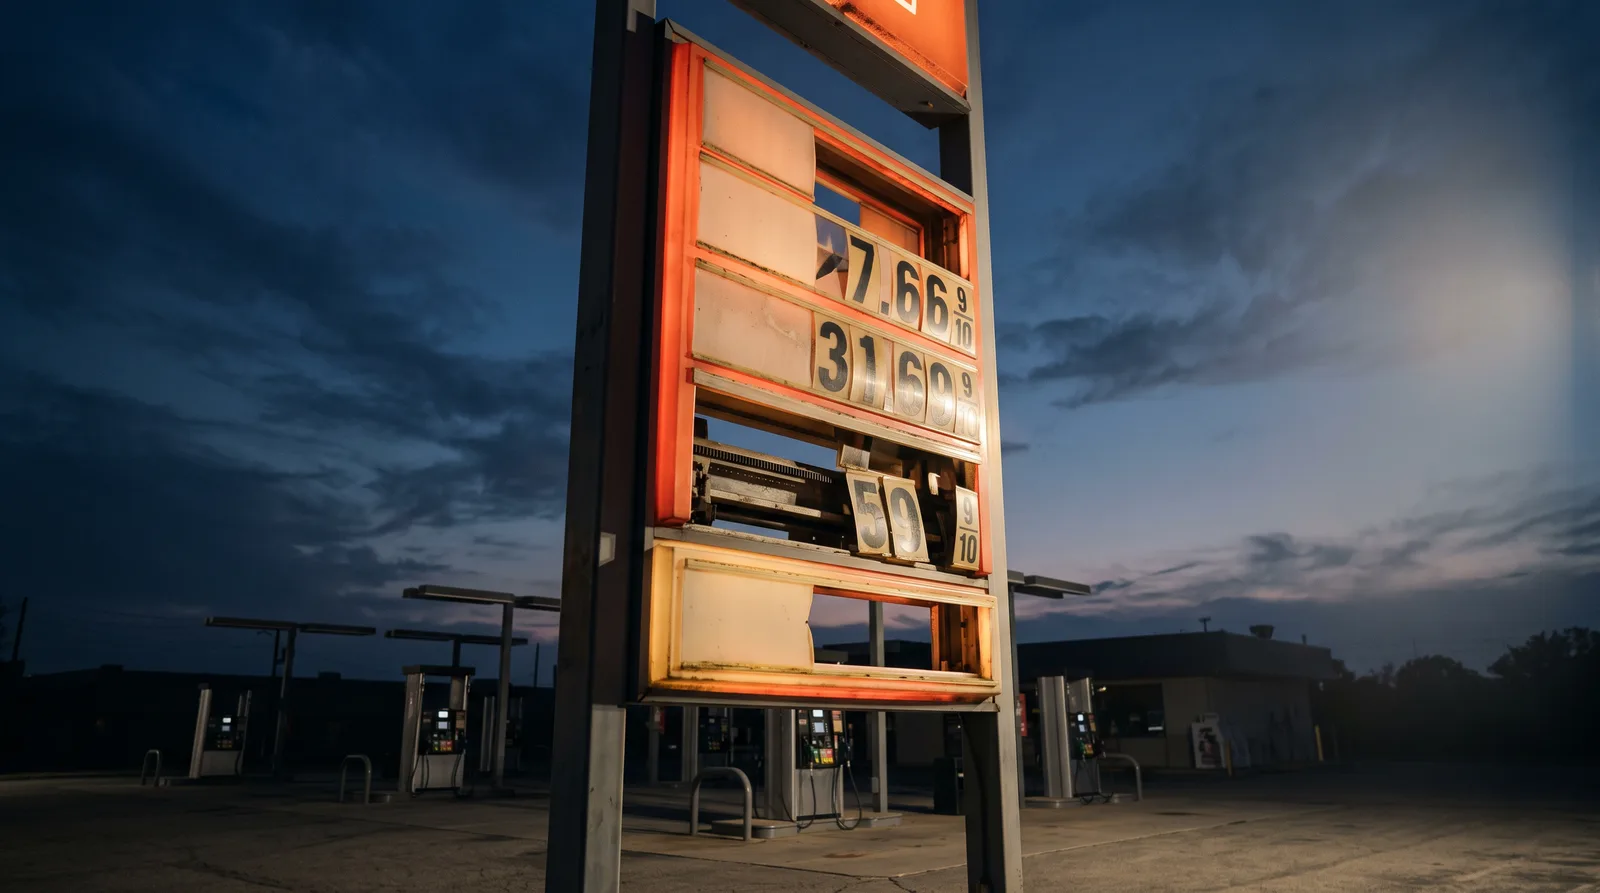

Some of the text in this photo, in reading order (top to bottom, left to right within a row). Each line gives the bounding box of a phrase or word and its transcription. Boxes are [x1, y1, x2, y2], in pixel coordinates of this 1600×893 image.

[850, 234, 948, 334] 7.66
[853, 480, 920, 553] 59
[960, 533, 978, 564] 10
